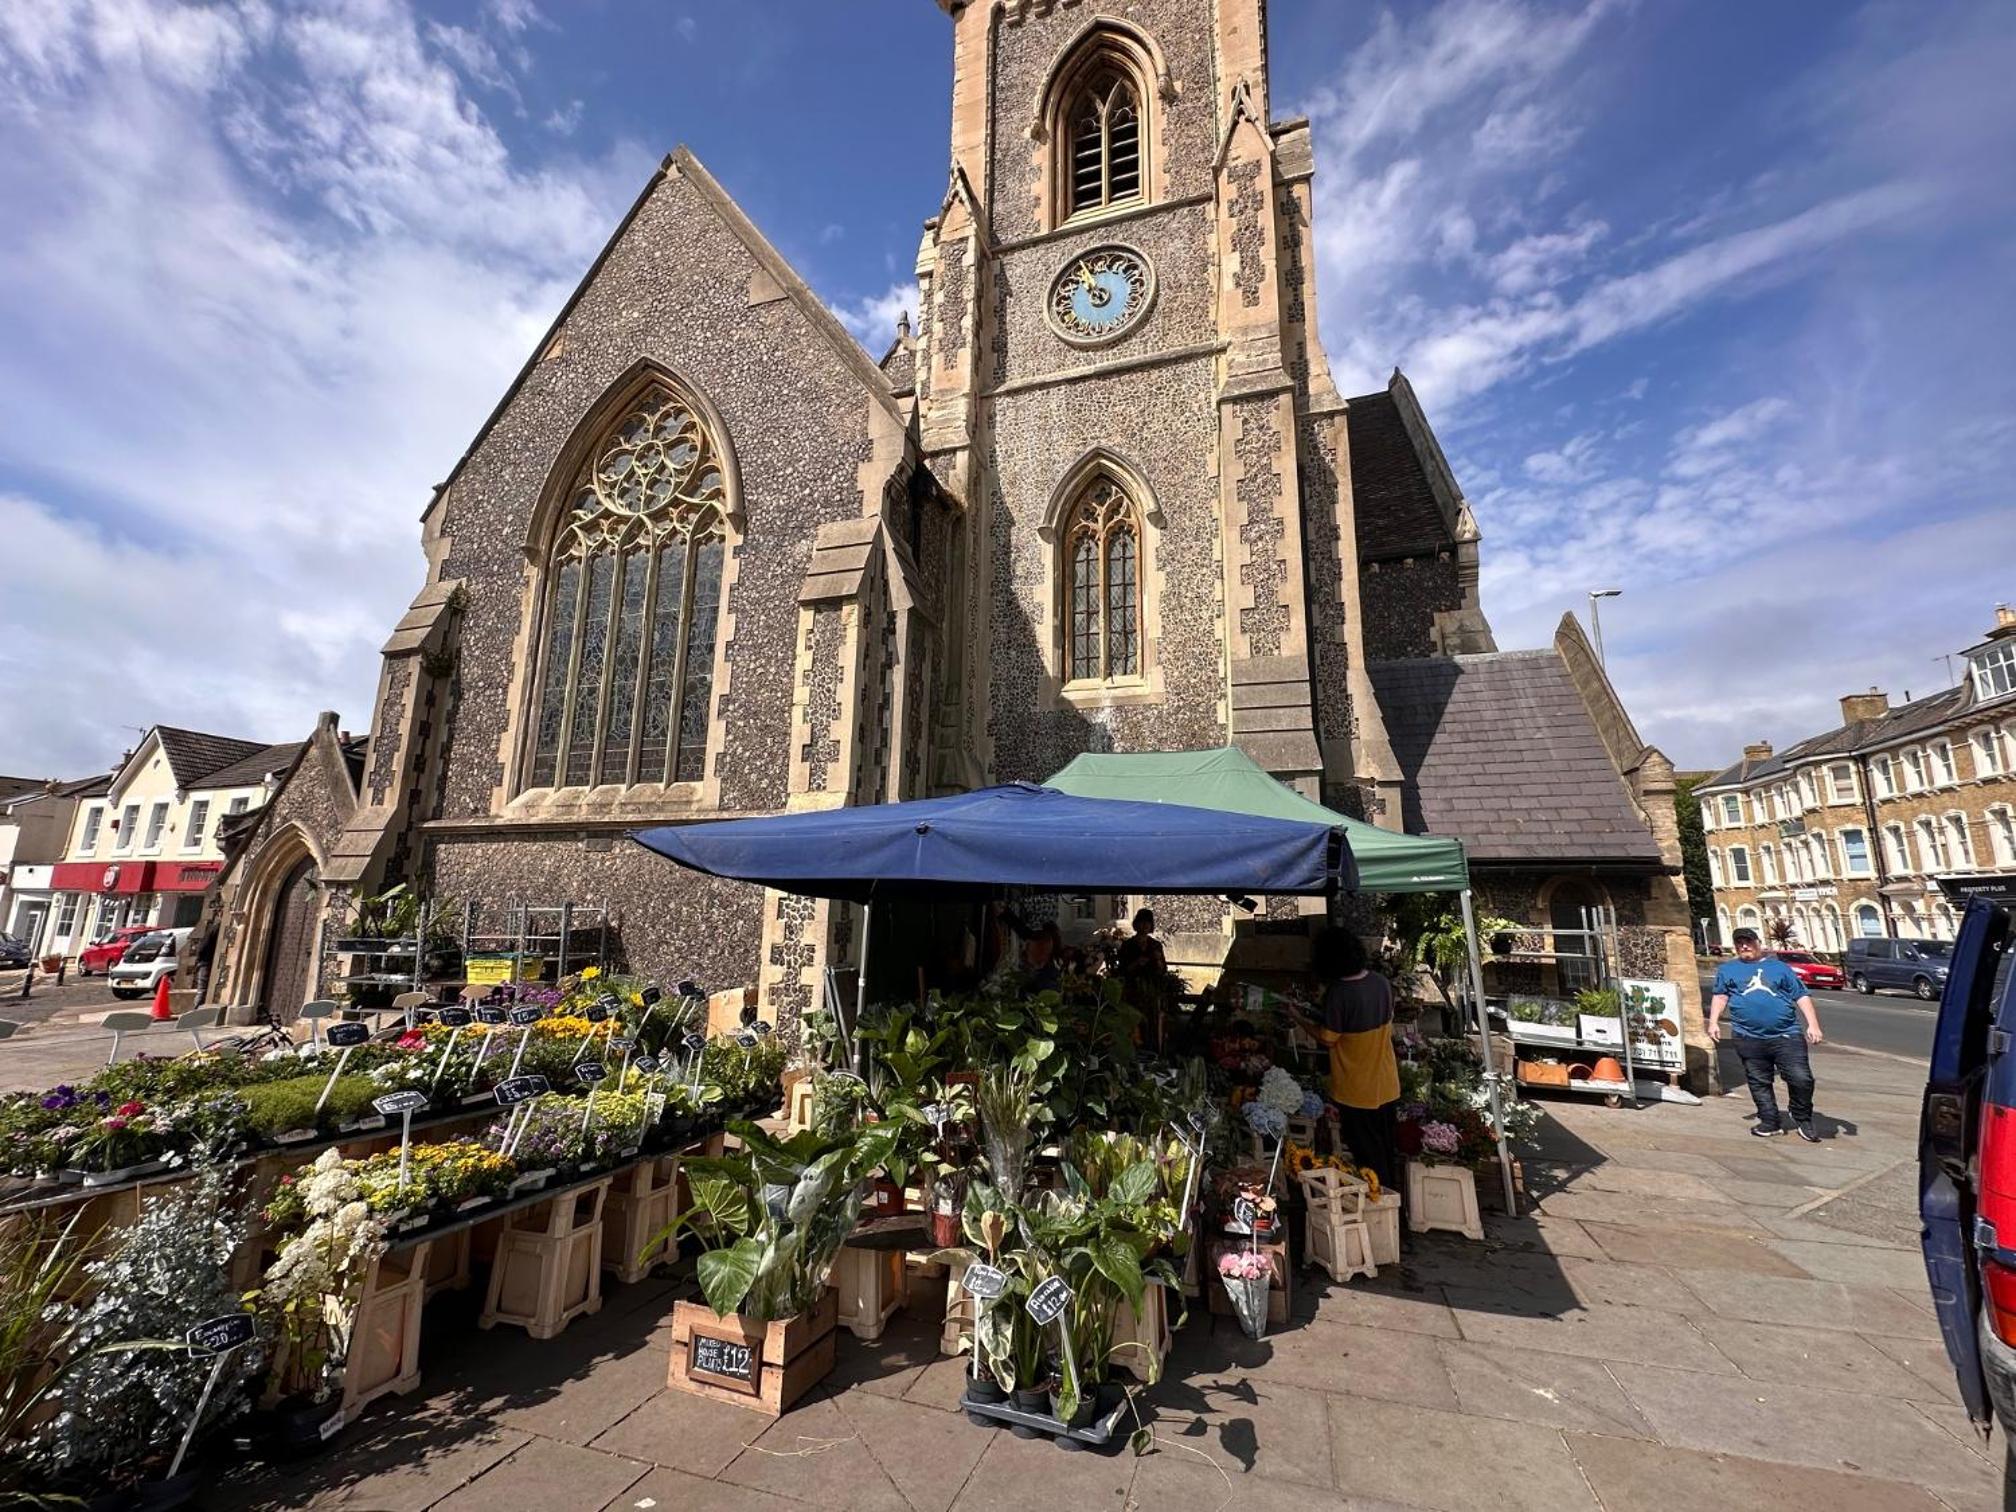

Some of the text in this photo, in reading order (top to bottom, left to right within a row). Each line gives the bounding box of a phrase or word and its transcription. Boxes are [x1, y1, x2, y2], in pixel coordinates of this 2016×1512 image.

[698, 1337, 721, 1348] MIXED
[698, 1345, 751, 1374] HOUSE £12
